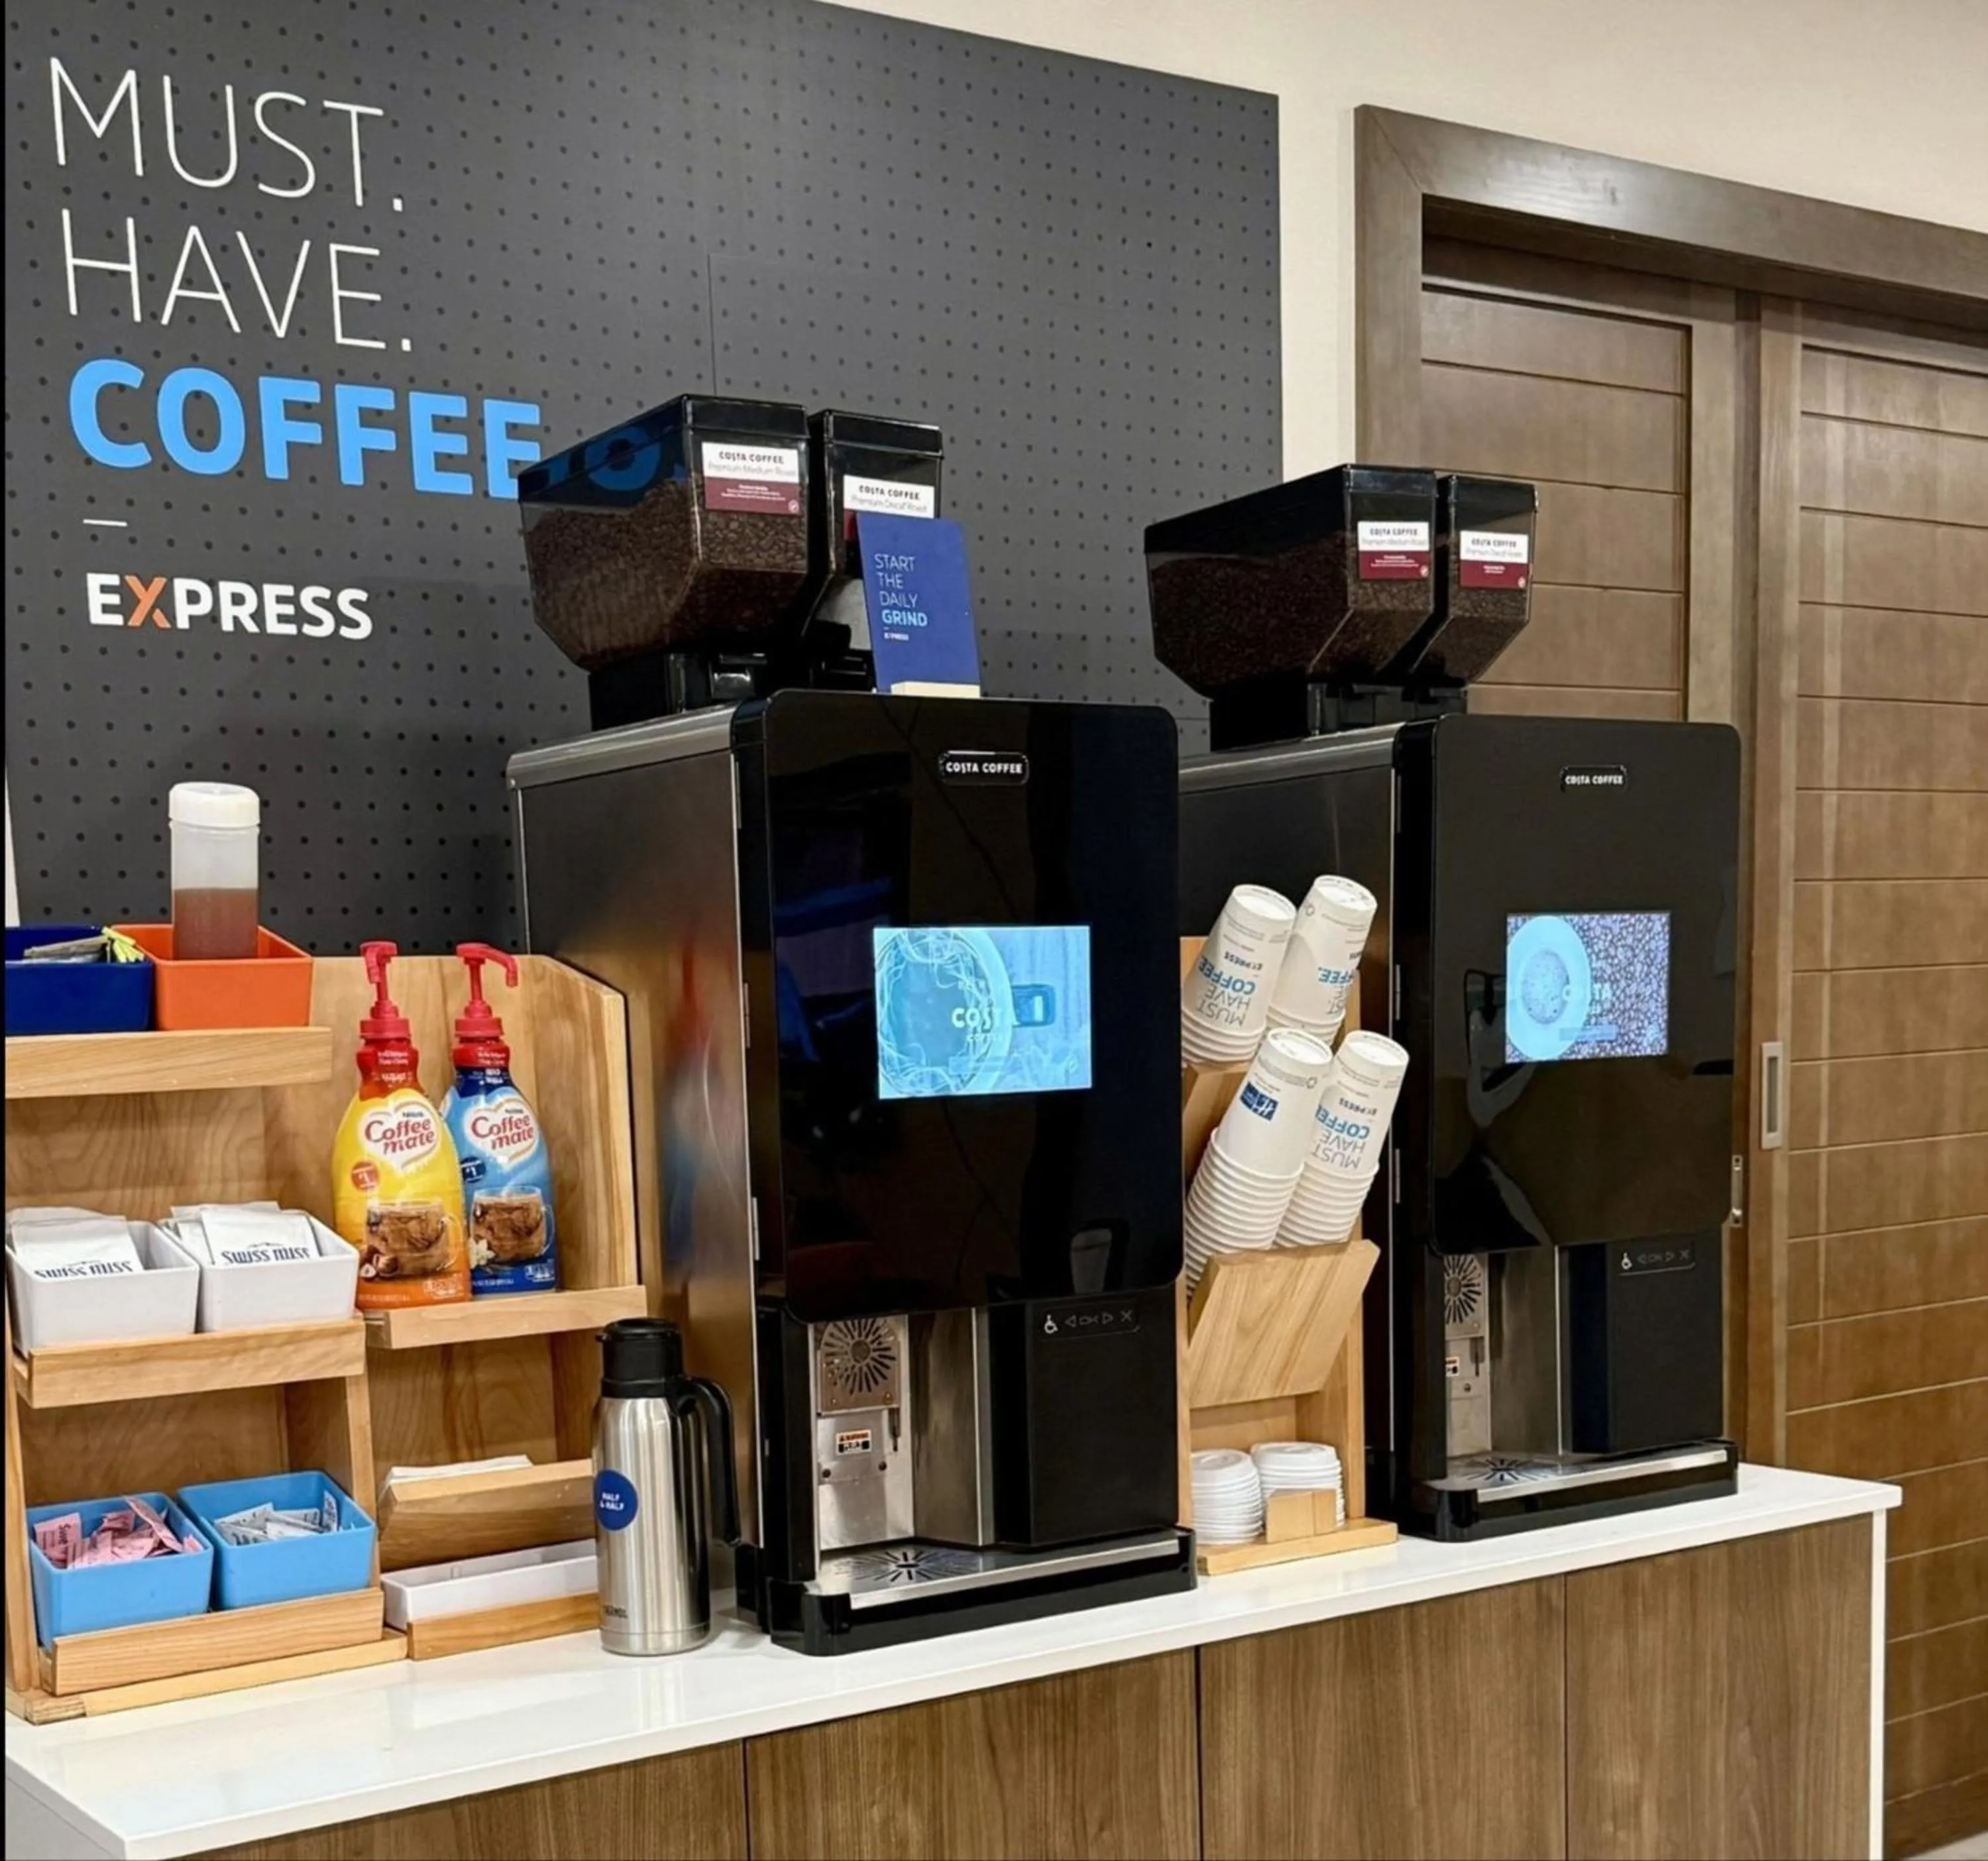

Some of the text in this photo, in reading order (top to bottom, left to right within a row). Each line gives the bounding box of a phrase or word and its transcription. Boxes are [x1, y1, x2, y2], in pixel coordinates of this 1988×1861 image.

[50, 56, 402, 211] MUST.
[62, 208, 412, 352] HAVE.
[69, 359, 540, 500] COFFEE
[718, 451, 785, 465] COSTA COFFEE
[858, 484, 920, 500] COSTA COFFEE
[874, 553, 916, 572] START
[877, 572, 904, 589] THE
[85, 572, 373, 640] EXPRESS
[879, 591, 918, 608] DAILY
[881, 610, 928, 626] GRIND
[945, 761, 1023, 773] COSTA COFFEE
[364, 1119, 431, 1143] Coffee
[471, 1115, 530, 1139] Coffee
[491, 1127, 533, 1151] mate
[383, 1131, 435, 1155] mate
